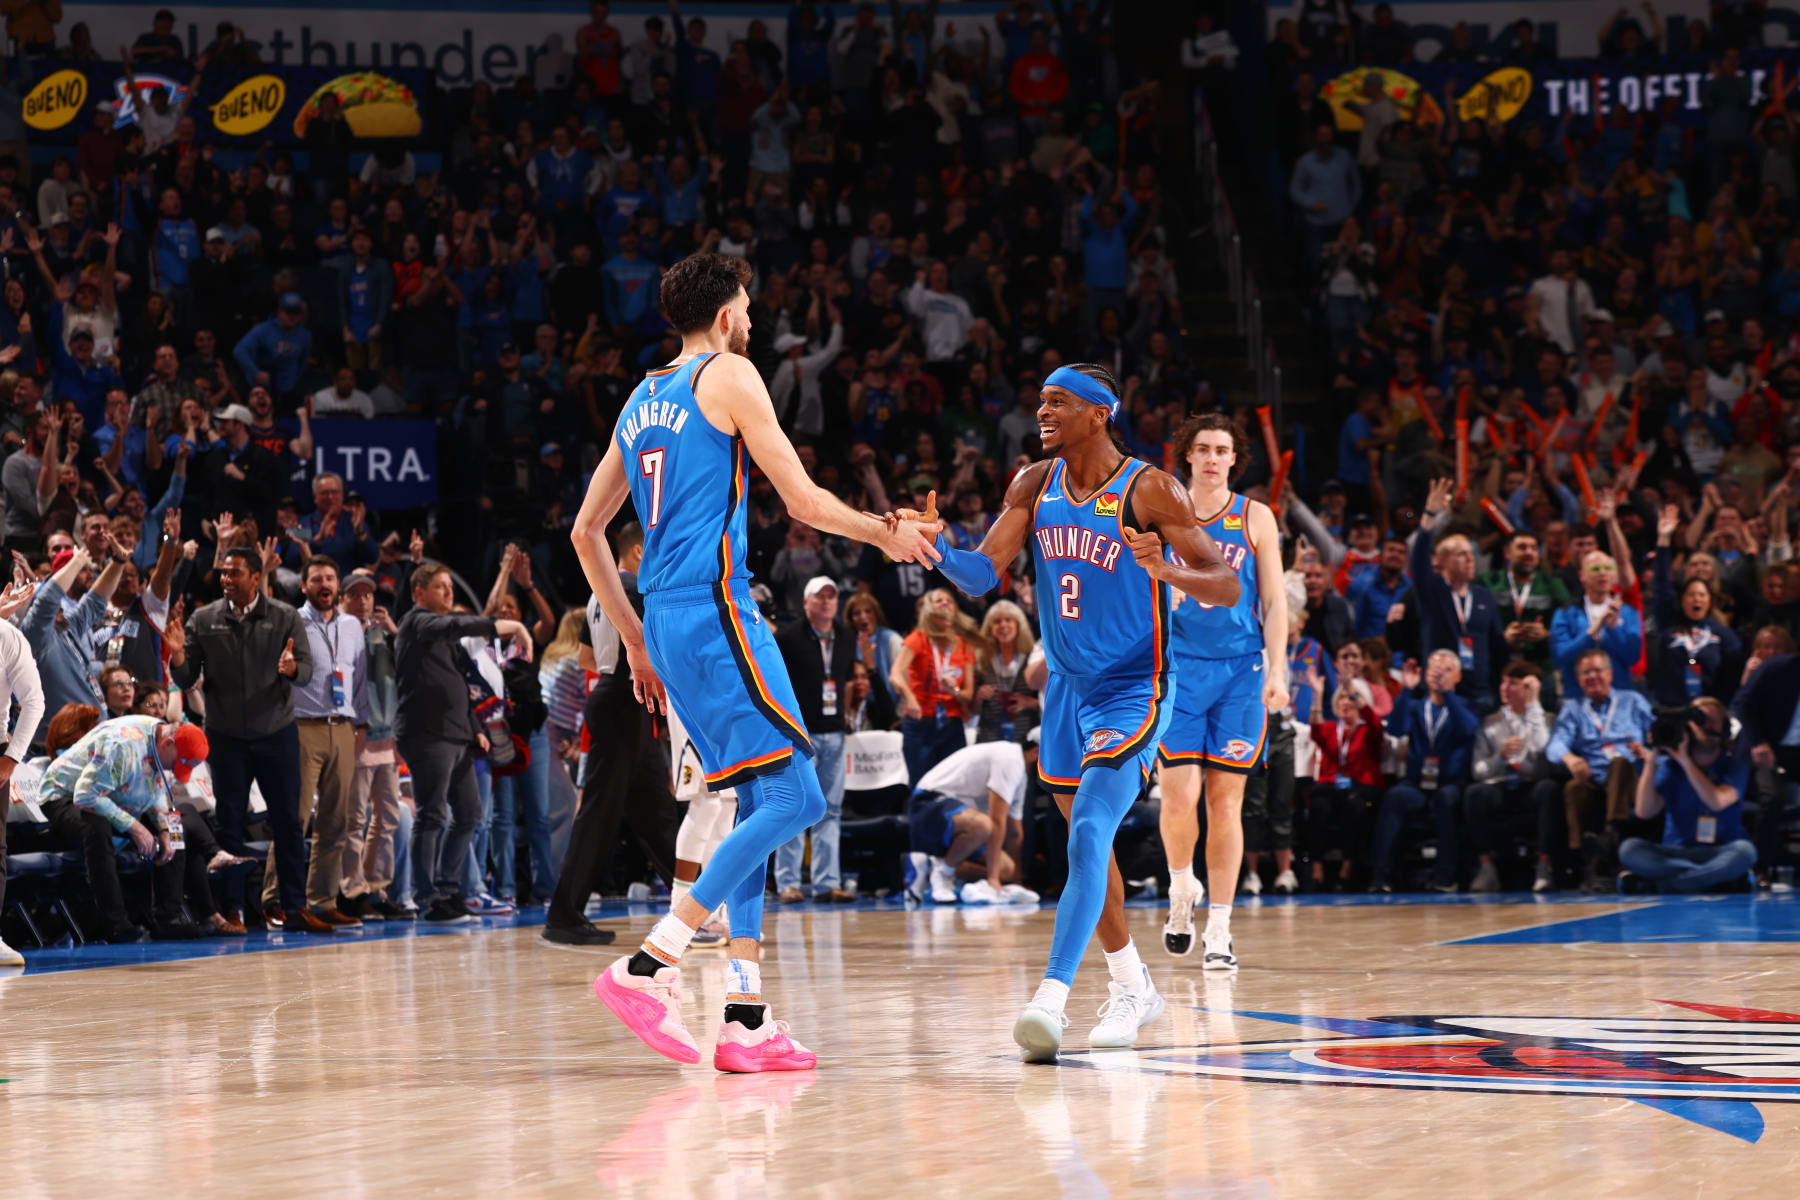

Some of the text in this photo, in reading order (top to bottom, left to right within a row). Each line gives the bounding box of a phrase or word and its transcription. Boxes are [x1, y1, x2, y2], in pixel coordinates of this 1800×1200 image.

[26, 79, 82, 117] BUENO
[218, 83, 280, 123] BUENO
[1543, 77, 1611, 116] THE
[620, 400, 689, 450] HOLMGREN
[638, 446, 665, 530] 7
[1035, 525, 1122, 573] THUNDER
[896, 564, 926, 598] 15
[1060, 572, 1081, 621] 2
